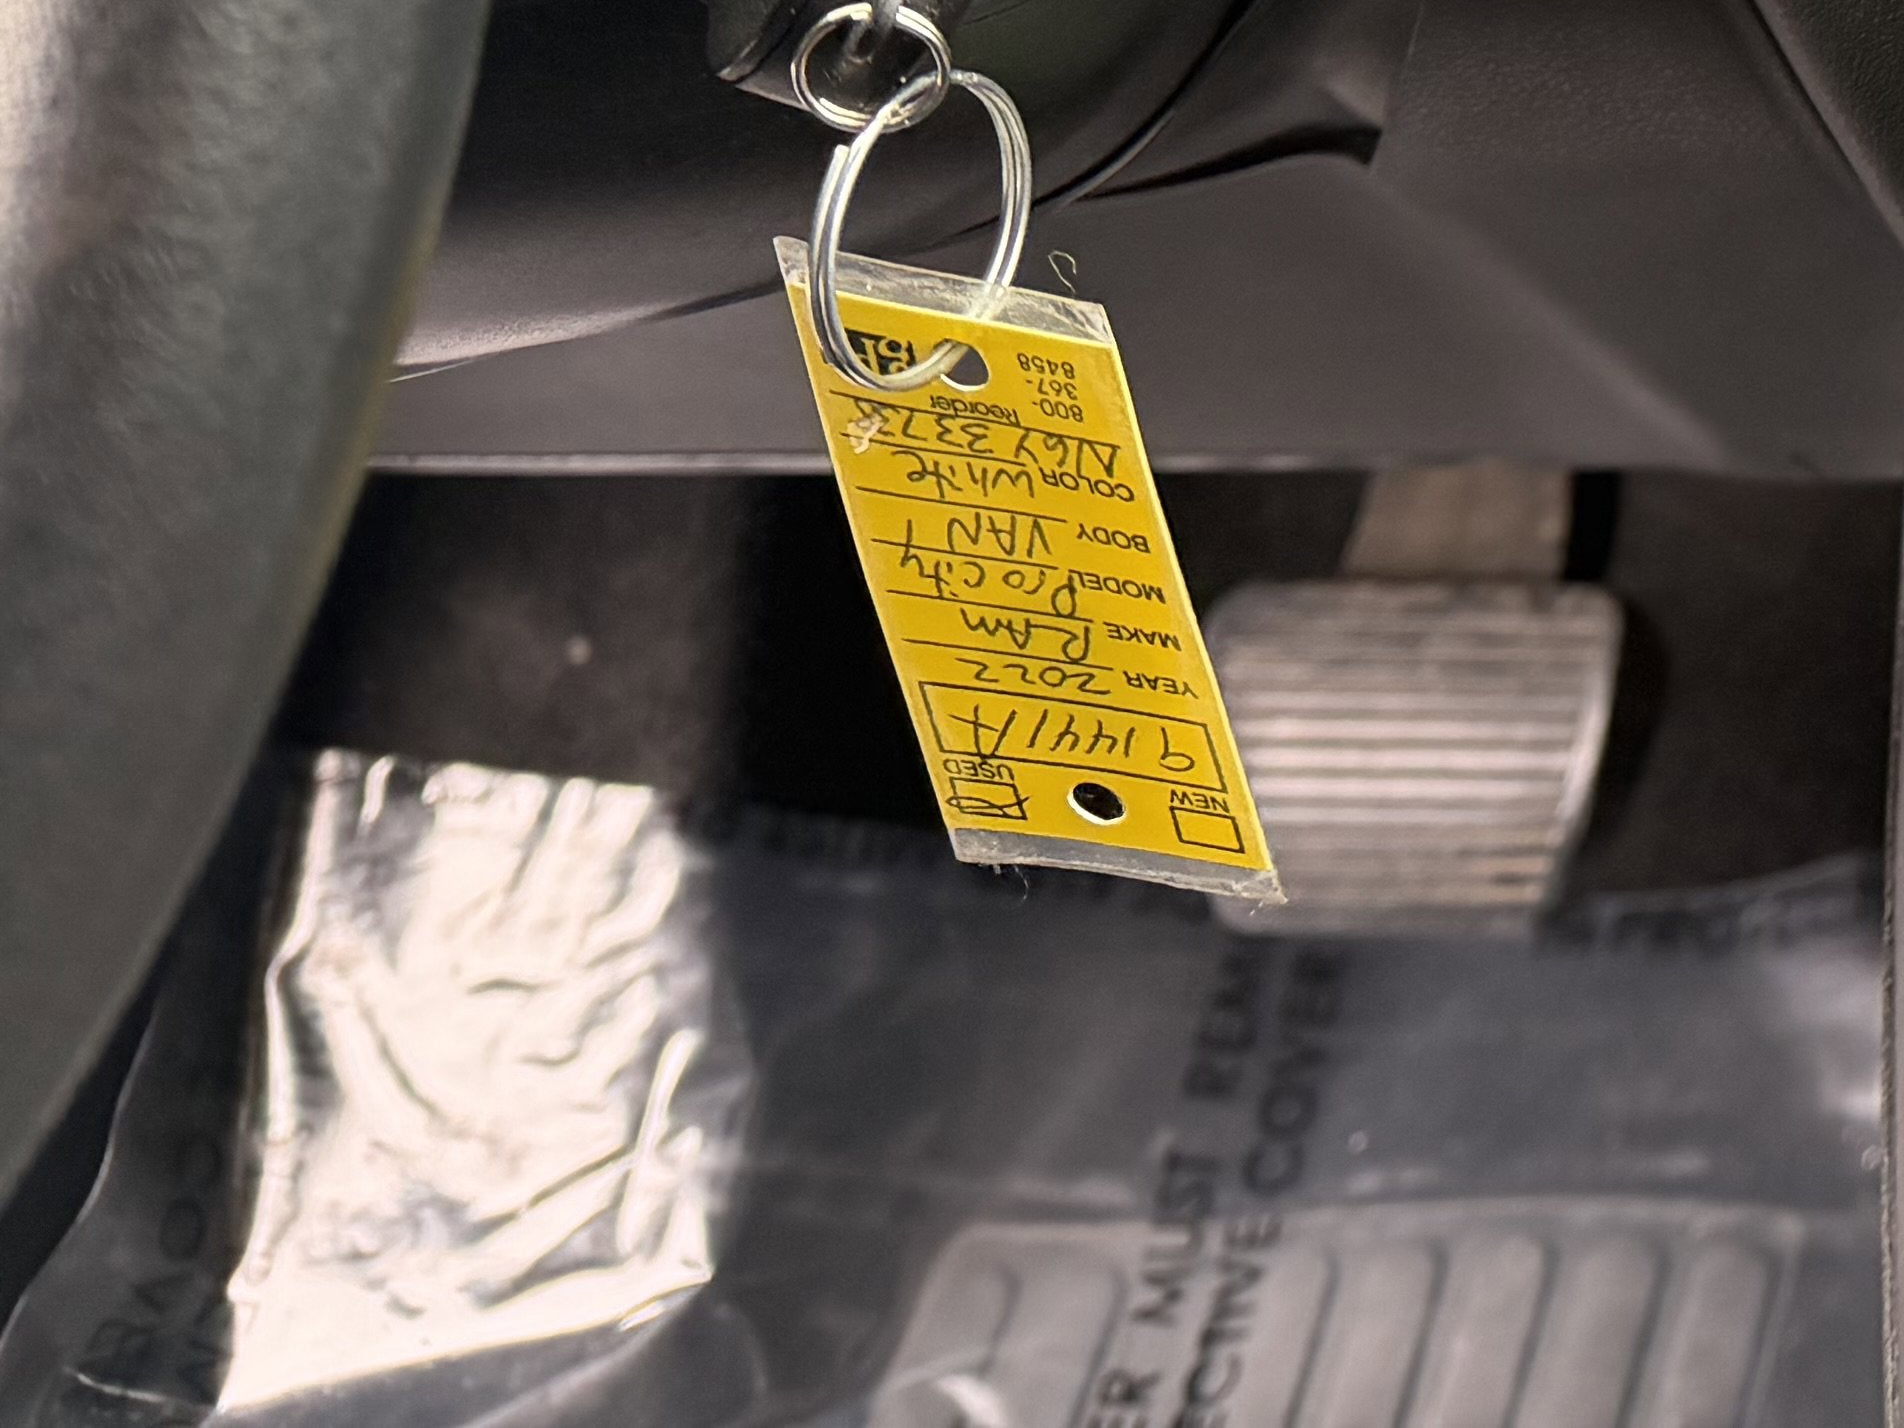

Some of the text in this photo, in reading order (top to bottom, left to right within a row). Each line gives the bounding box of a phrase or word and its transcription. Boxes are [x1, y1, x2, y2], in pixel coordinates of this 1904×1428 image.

[1017, 352, 1076, 380] 8458
[929, 394, 1022, 427] Reorder
[1031, 396, 1085, 423] 800-
[1038, 466, 1136, 503] COLOR
[947, 511, 1152, 560] BODY VAN
[1067, 569, 1167, 605] MODEL
[1102, 620, 1183, 652] MAKE
[953, 657, 1199, 699] YEAR 2022
[942, 758, 1016, 781] USED
[1169, 789, 1231, 814] NEW
